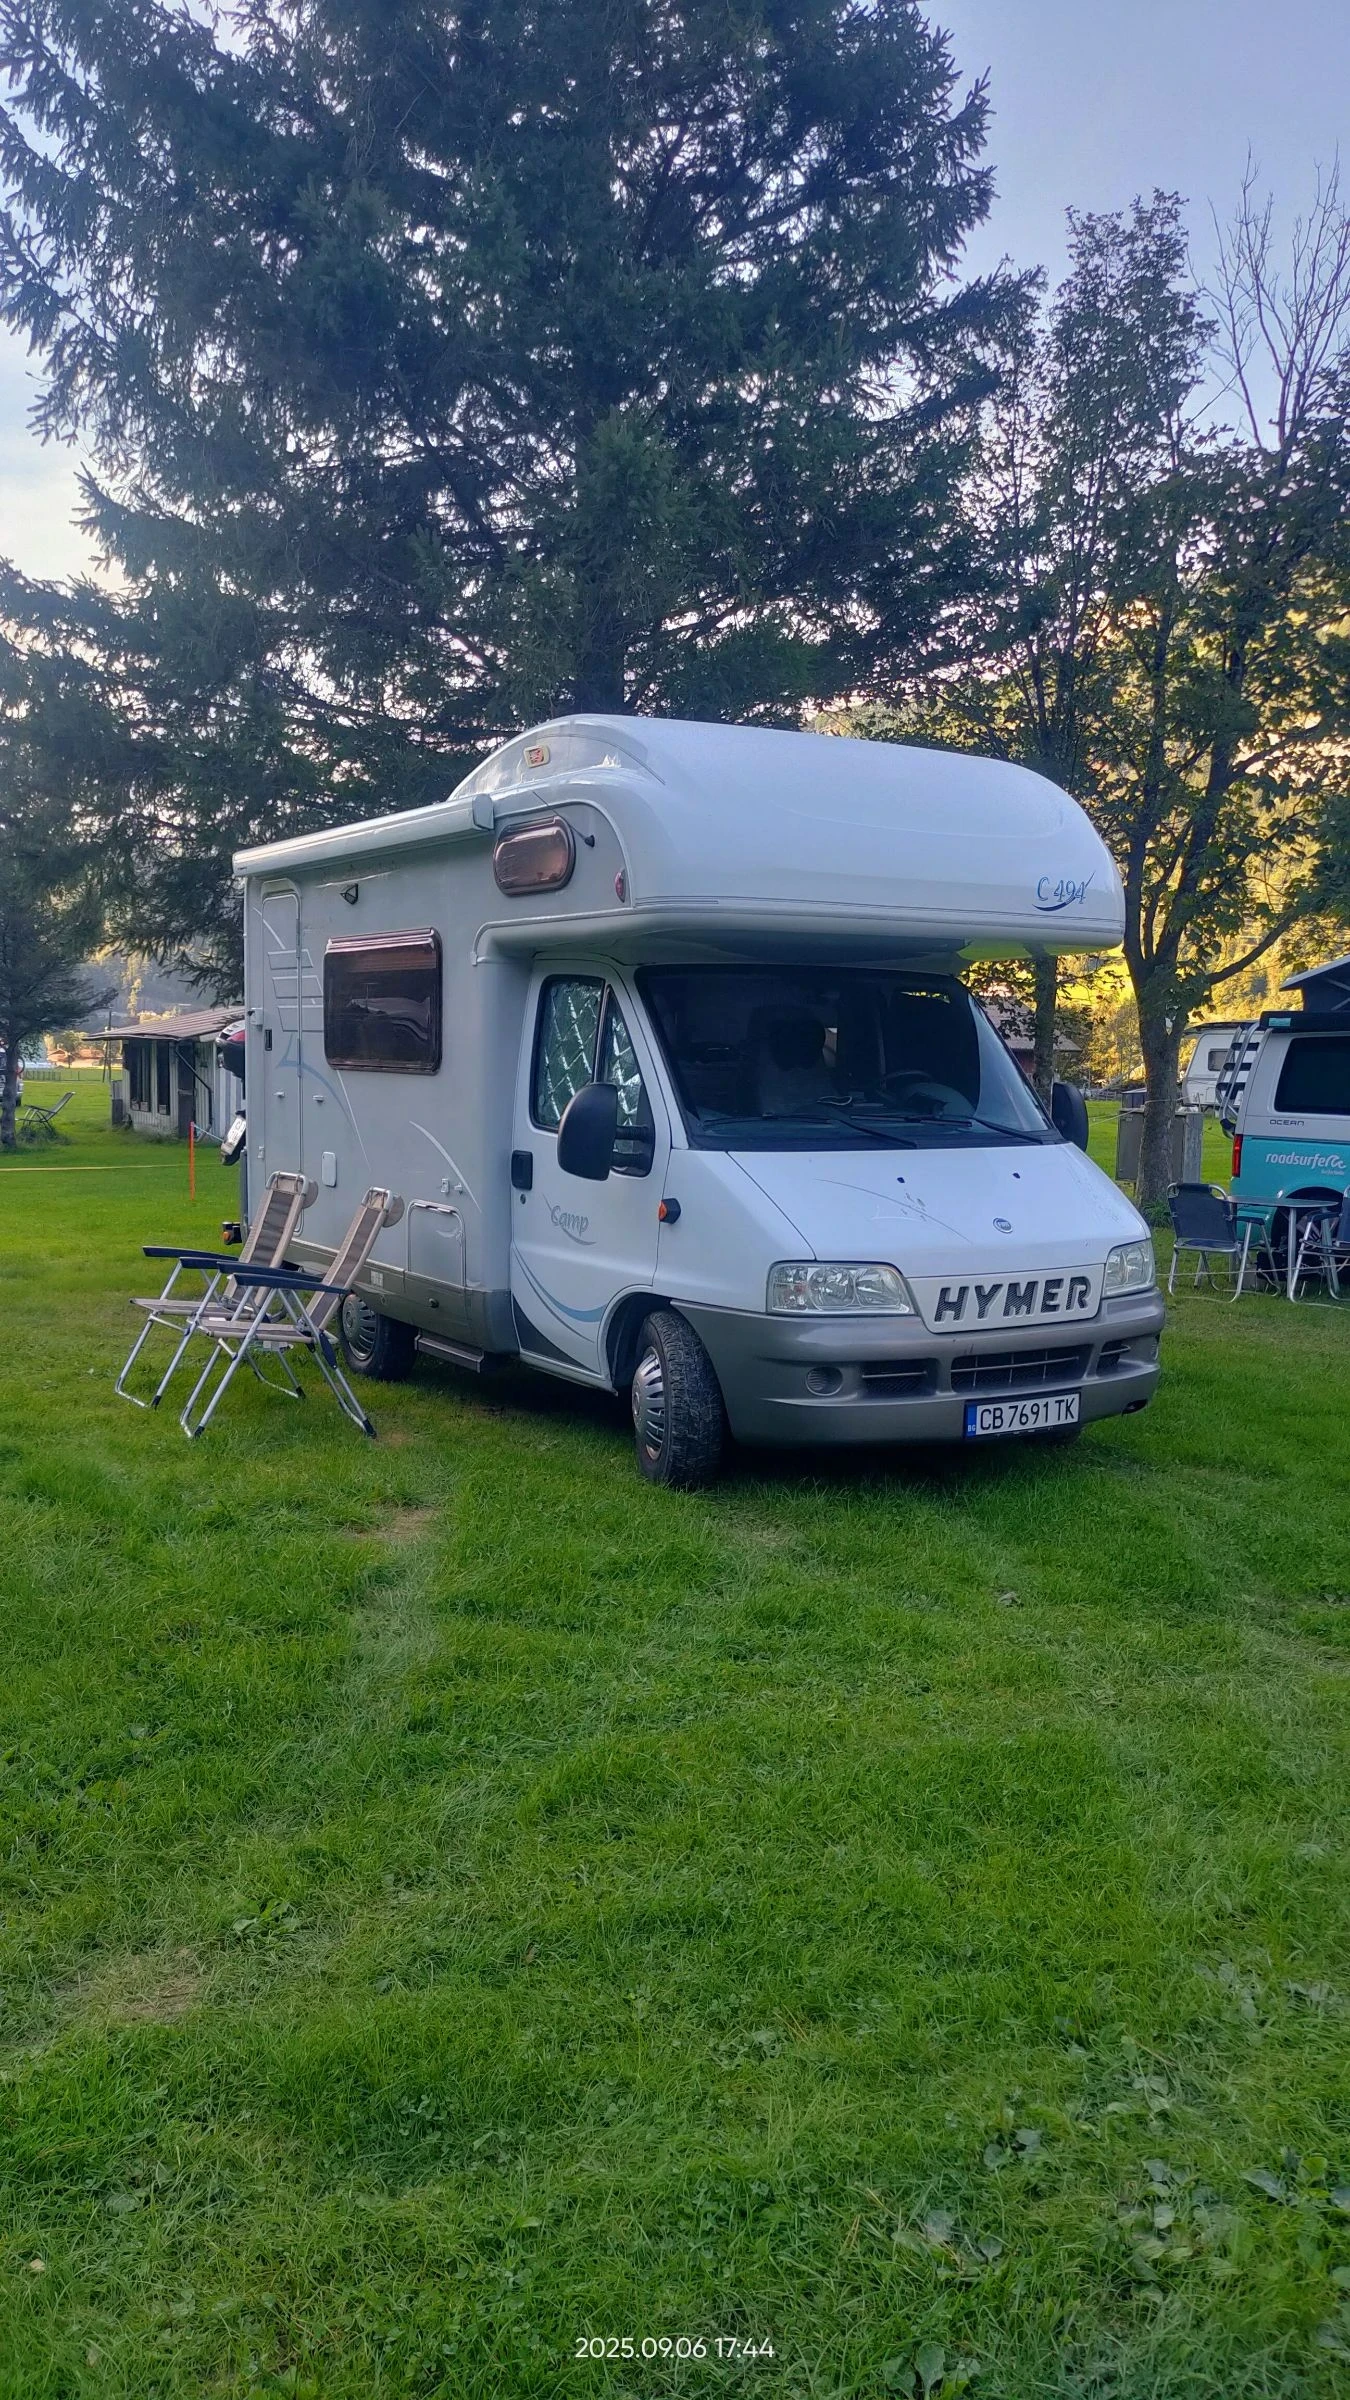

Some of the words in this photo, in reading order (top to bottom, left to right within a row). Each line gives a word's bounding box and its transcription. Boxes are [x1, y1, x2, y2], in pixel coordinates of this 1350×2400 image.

[1037, 876, 1050, 902] C
[1053, 879, 1087, 905] 494
[1269, 1119, 1305, 1127] OCEAN
[550, 1205, 590, 1237] Camp
[934, 1275, 1093, 1323] HYMER
